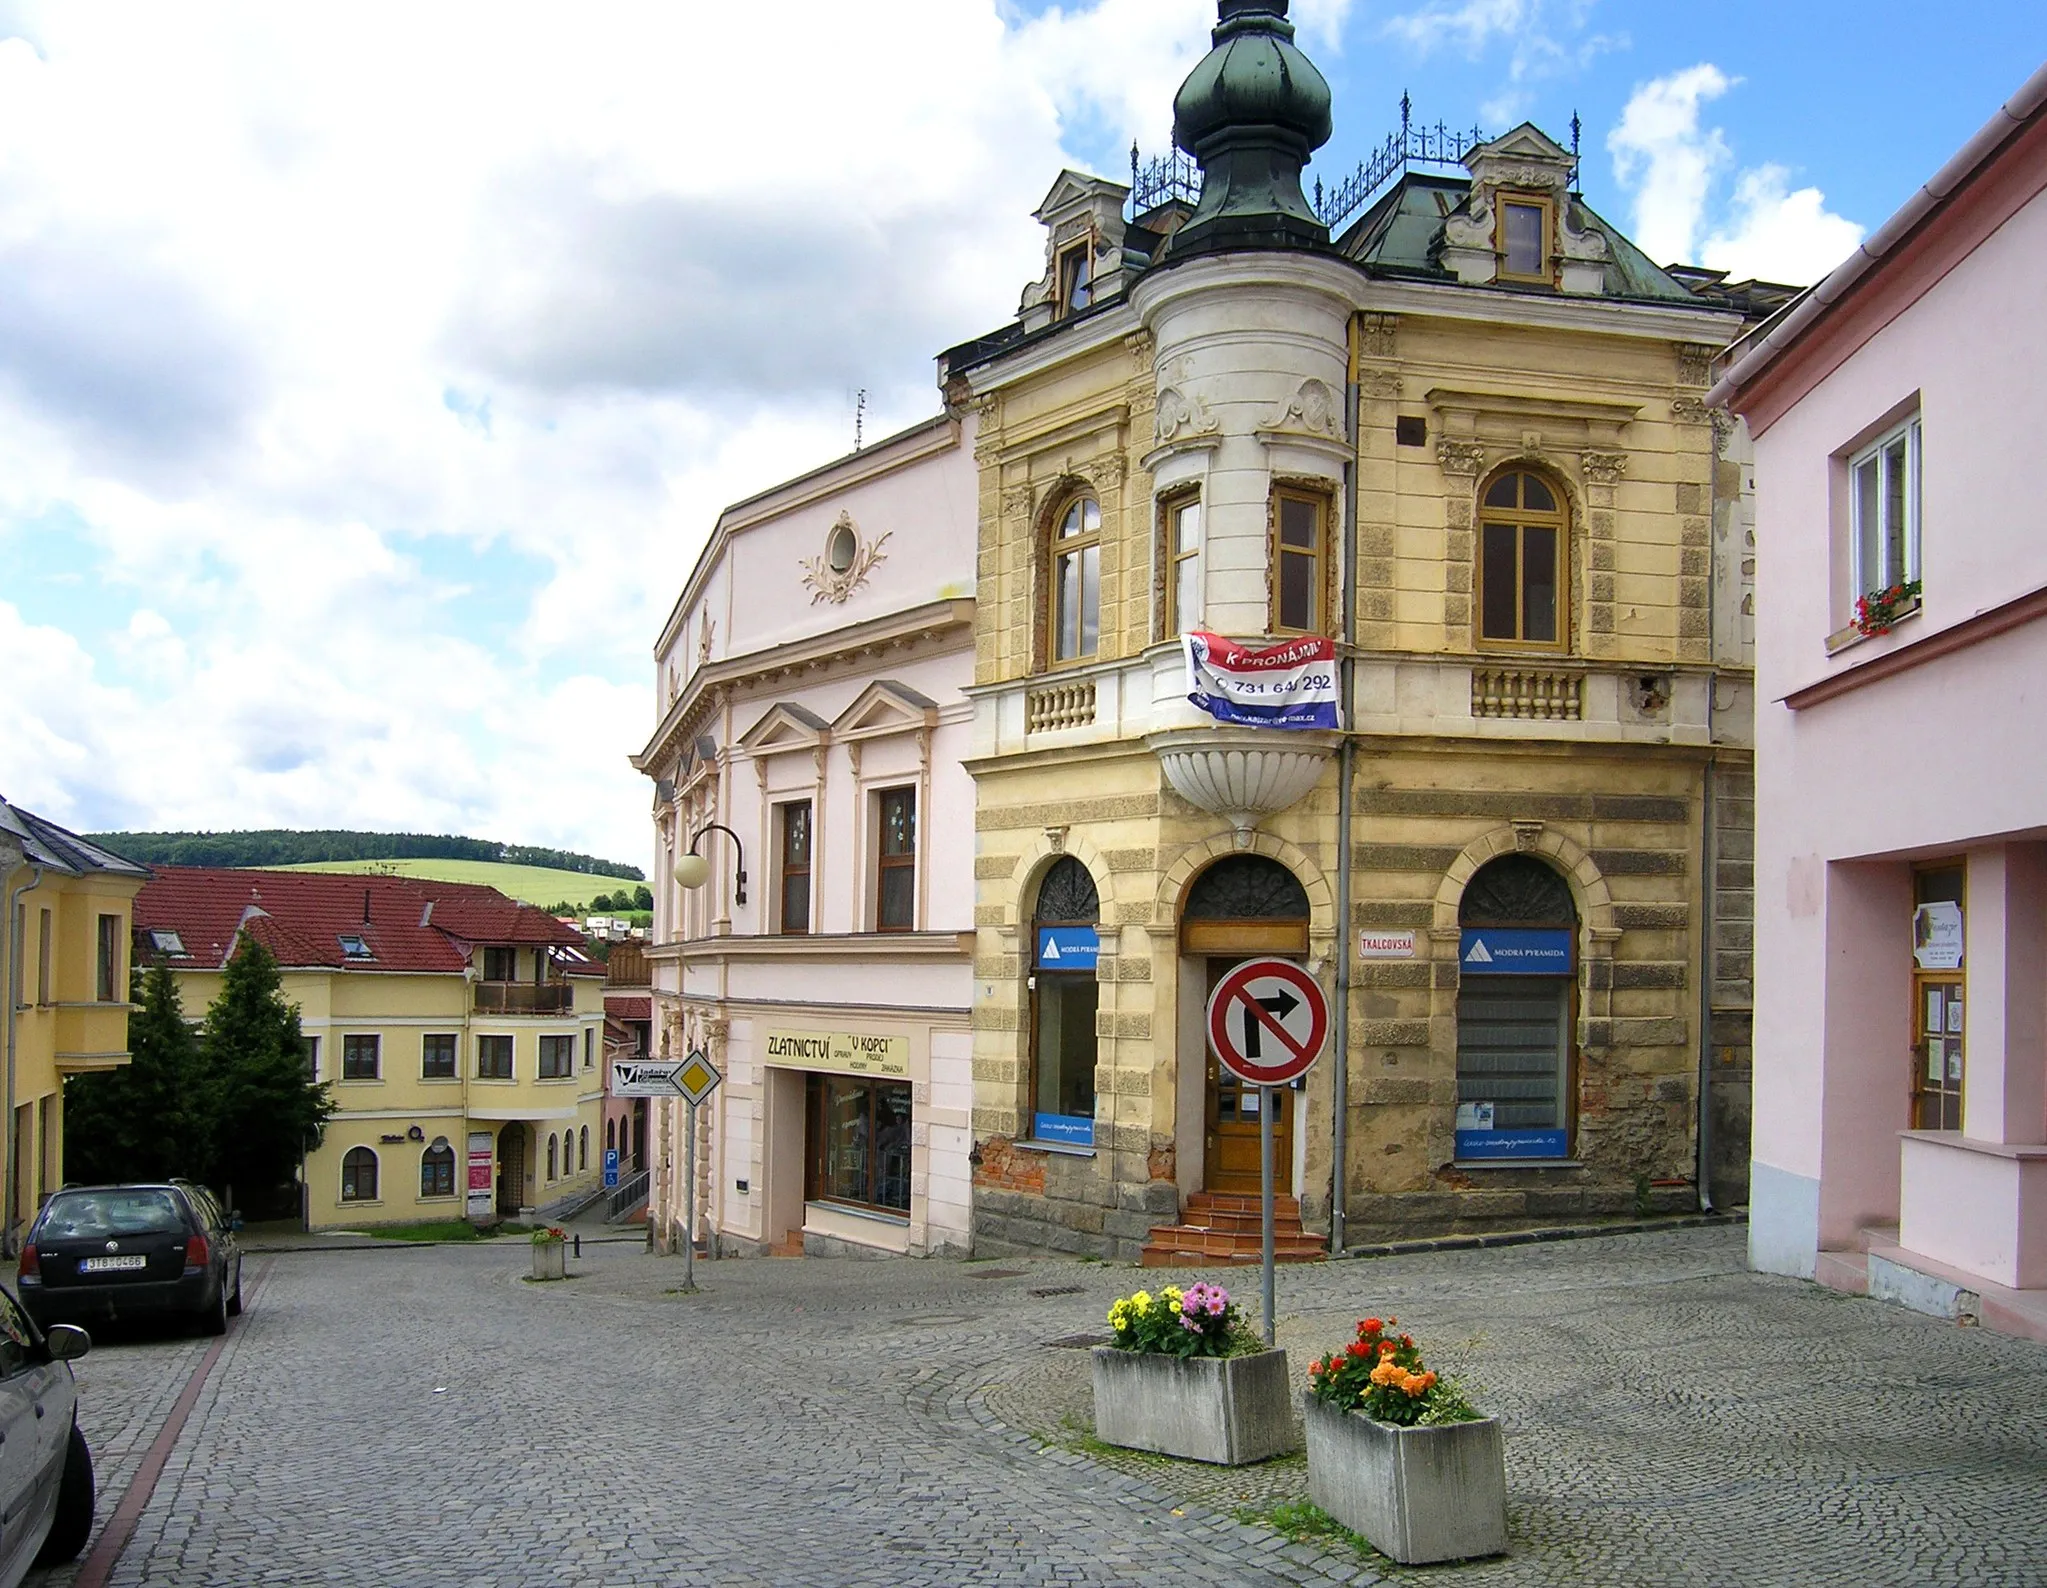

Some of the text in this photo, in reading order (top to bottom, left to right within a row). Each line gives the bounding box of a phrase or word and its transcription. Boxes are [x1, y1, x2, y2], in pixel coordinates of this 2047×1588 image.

[1226, 652, 1239, 665] K
[1234, 681, 1265, 694] 731
[1302, 675, 1332, 690] 292
[1362, 938, 1413, 950] TKALCOVSKÁ
[1494, 948, 1565, 958] MODRÁ PYRAMIDA
[768, 1036, 831, 1060] ZLATNICTVÍ
[607, 1152, 616, 1165] P
[115, 1256, 142, 1267] 0466
